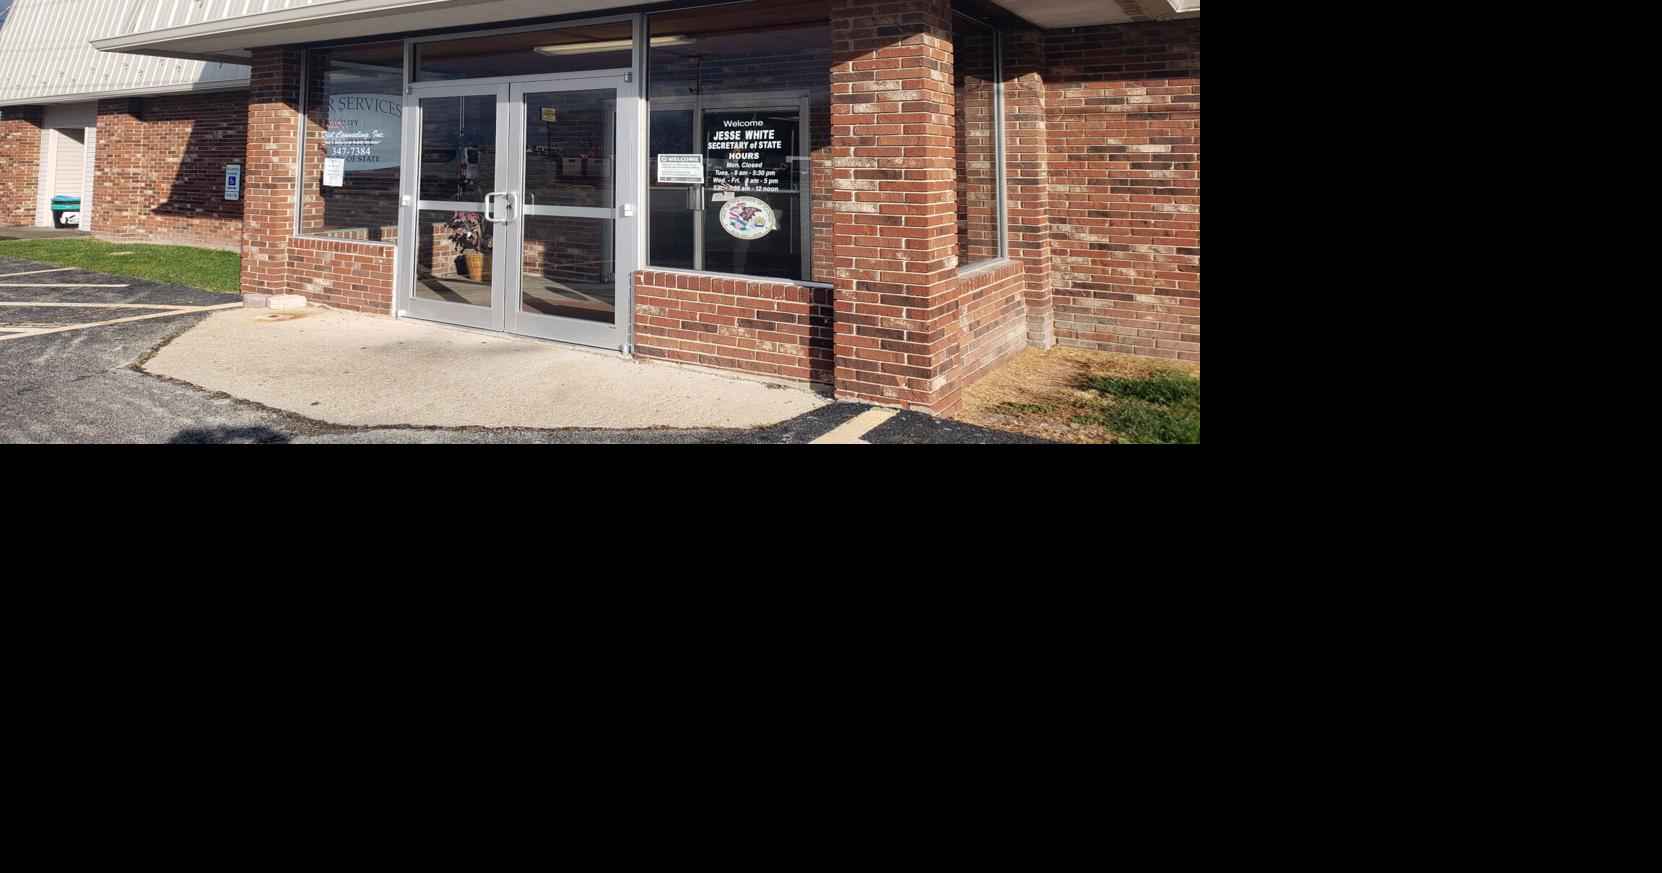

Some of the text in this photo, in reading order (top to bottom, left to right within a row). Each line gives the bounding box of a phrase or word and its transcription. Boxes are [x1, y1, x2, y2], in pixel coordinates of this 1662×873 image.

[338, 96, 402, 117] SERVICES
[372, 130, 384, 138] Inc.
[714, 130, 774, 140] JESSE WHITE
[708, 142, 748, 150] SECRETARY
[758, 140, 782, 148] STATE
[331, 147, 371, 156] 347-7384
